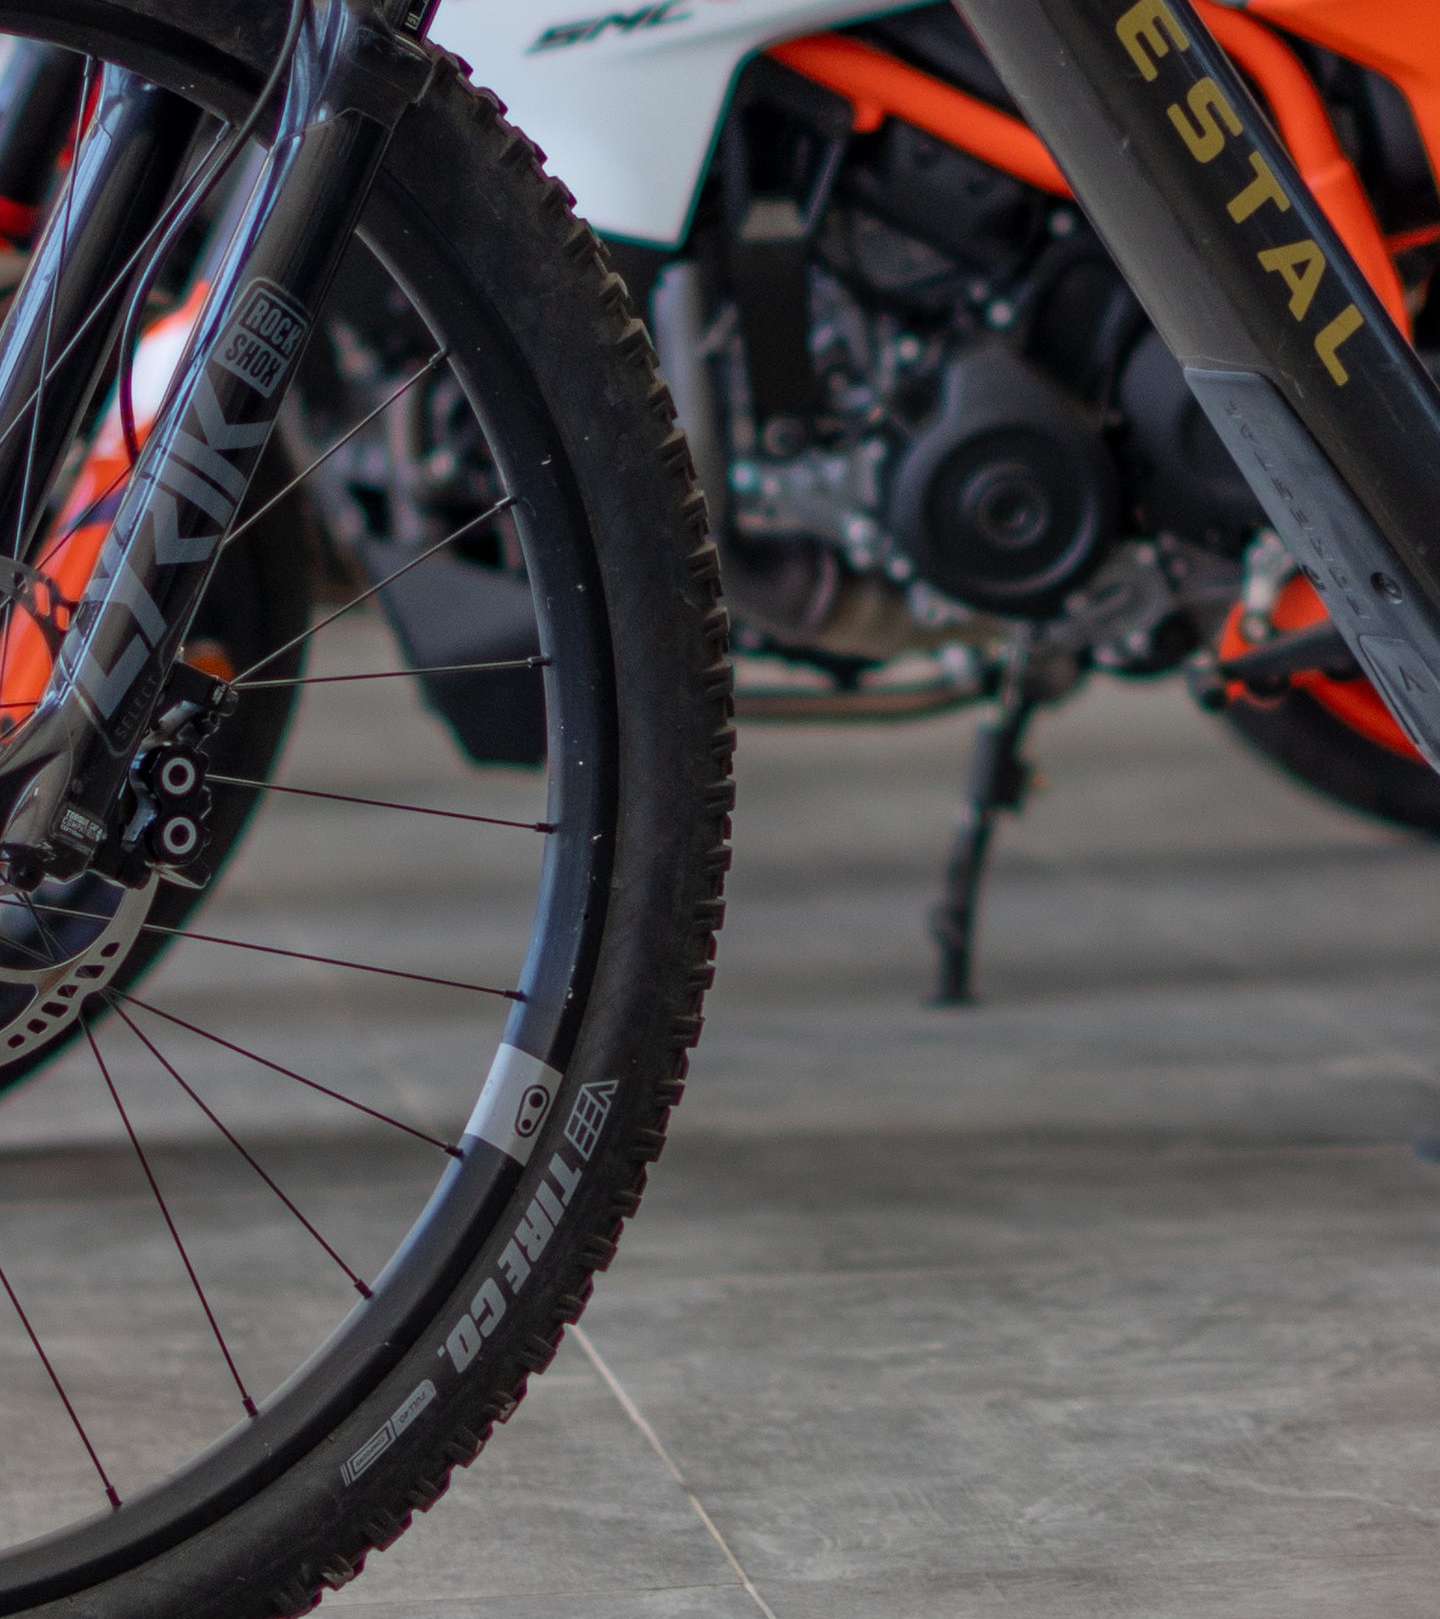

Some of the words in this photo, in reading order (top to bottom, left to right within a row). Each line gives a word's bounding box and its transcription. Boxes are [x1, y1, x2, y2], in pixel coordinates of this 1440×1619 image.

[225, 333, 281, 388] SHOX
[245, 298, 301, 355] ROCK
[497, 1151, 583, 1295] TIRE
[437, 1277, 507, 1374] CO.
